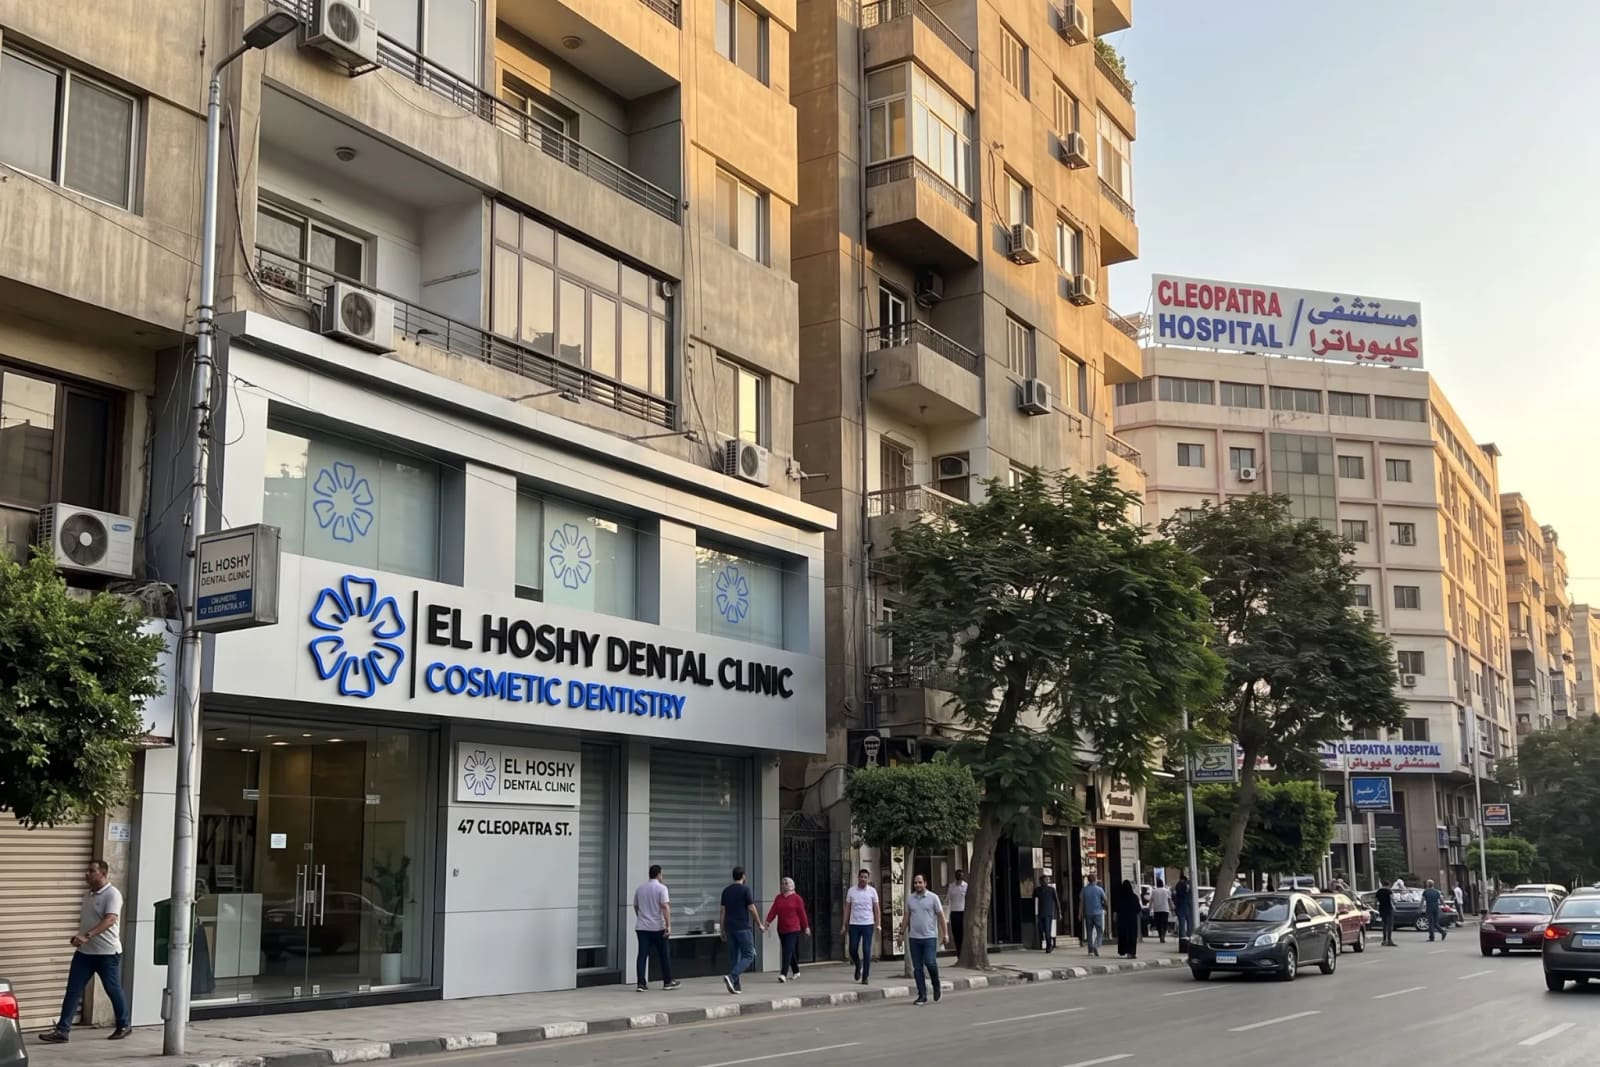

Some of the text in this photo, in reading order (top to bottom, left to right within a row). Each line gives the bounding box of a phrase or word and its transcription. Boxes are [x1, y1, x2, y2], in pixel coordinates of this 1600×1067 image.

[1157, 280, 1283, 318] CLEOPATRA
[1307, 296, 1418, 328] مستشفى
[1158, 313, 1284, 348] HOSPITAL
[1309, 328, 1419, 362] كليوباترا
[201, 554, 250, 574] EL HOSHY
[201, 570, 250, 586] DENTAL CLINIC
[427, 604, 794, 699] EL HOSHY DENTAL CLINIC
[425, 661, 687, 720] COSMETIC DENTISTRY
[1338, 743, 1392, 756] CLEOPATRA
[1394, 744, 1441, 756] HOSPITAL
[504, 758, 575, 778] EL HOSHY
[1394, 757, 1440, 771] مستشفى
[503, 778, 576, 793] DENTAL CLINIC
[457, 819, 572, 836] 47 CLEOPATRA ST.
